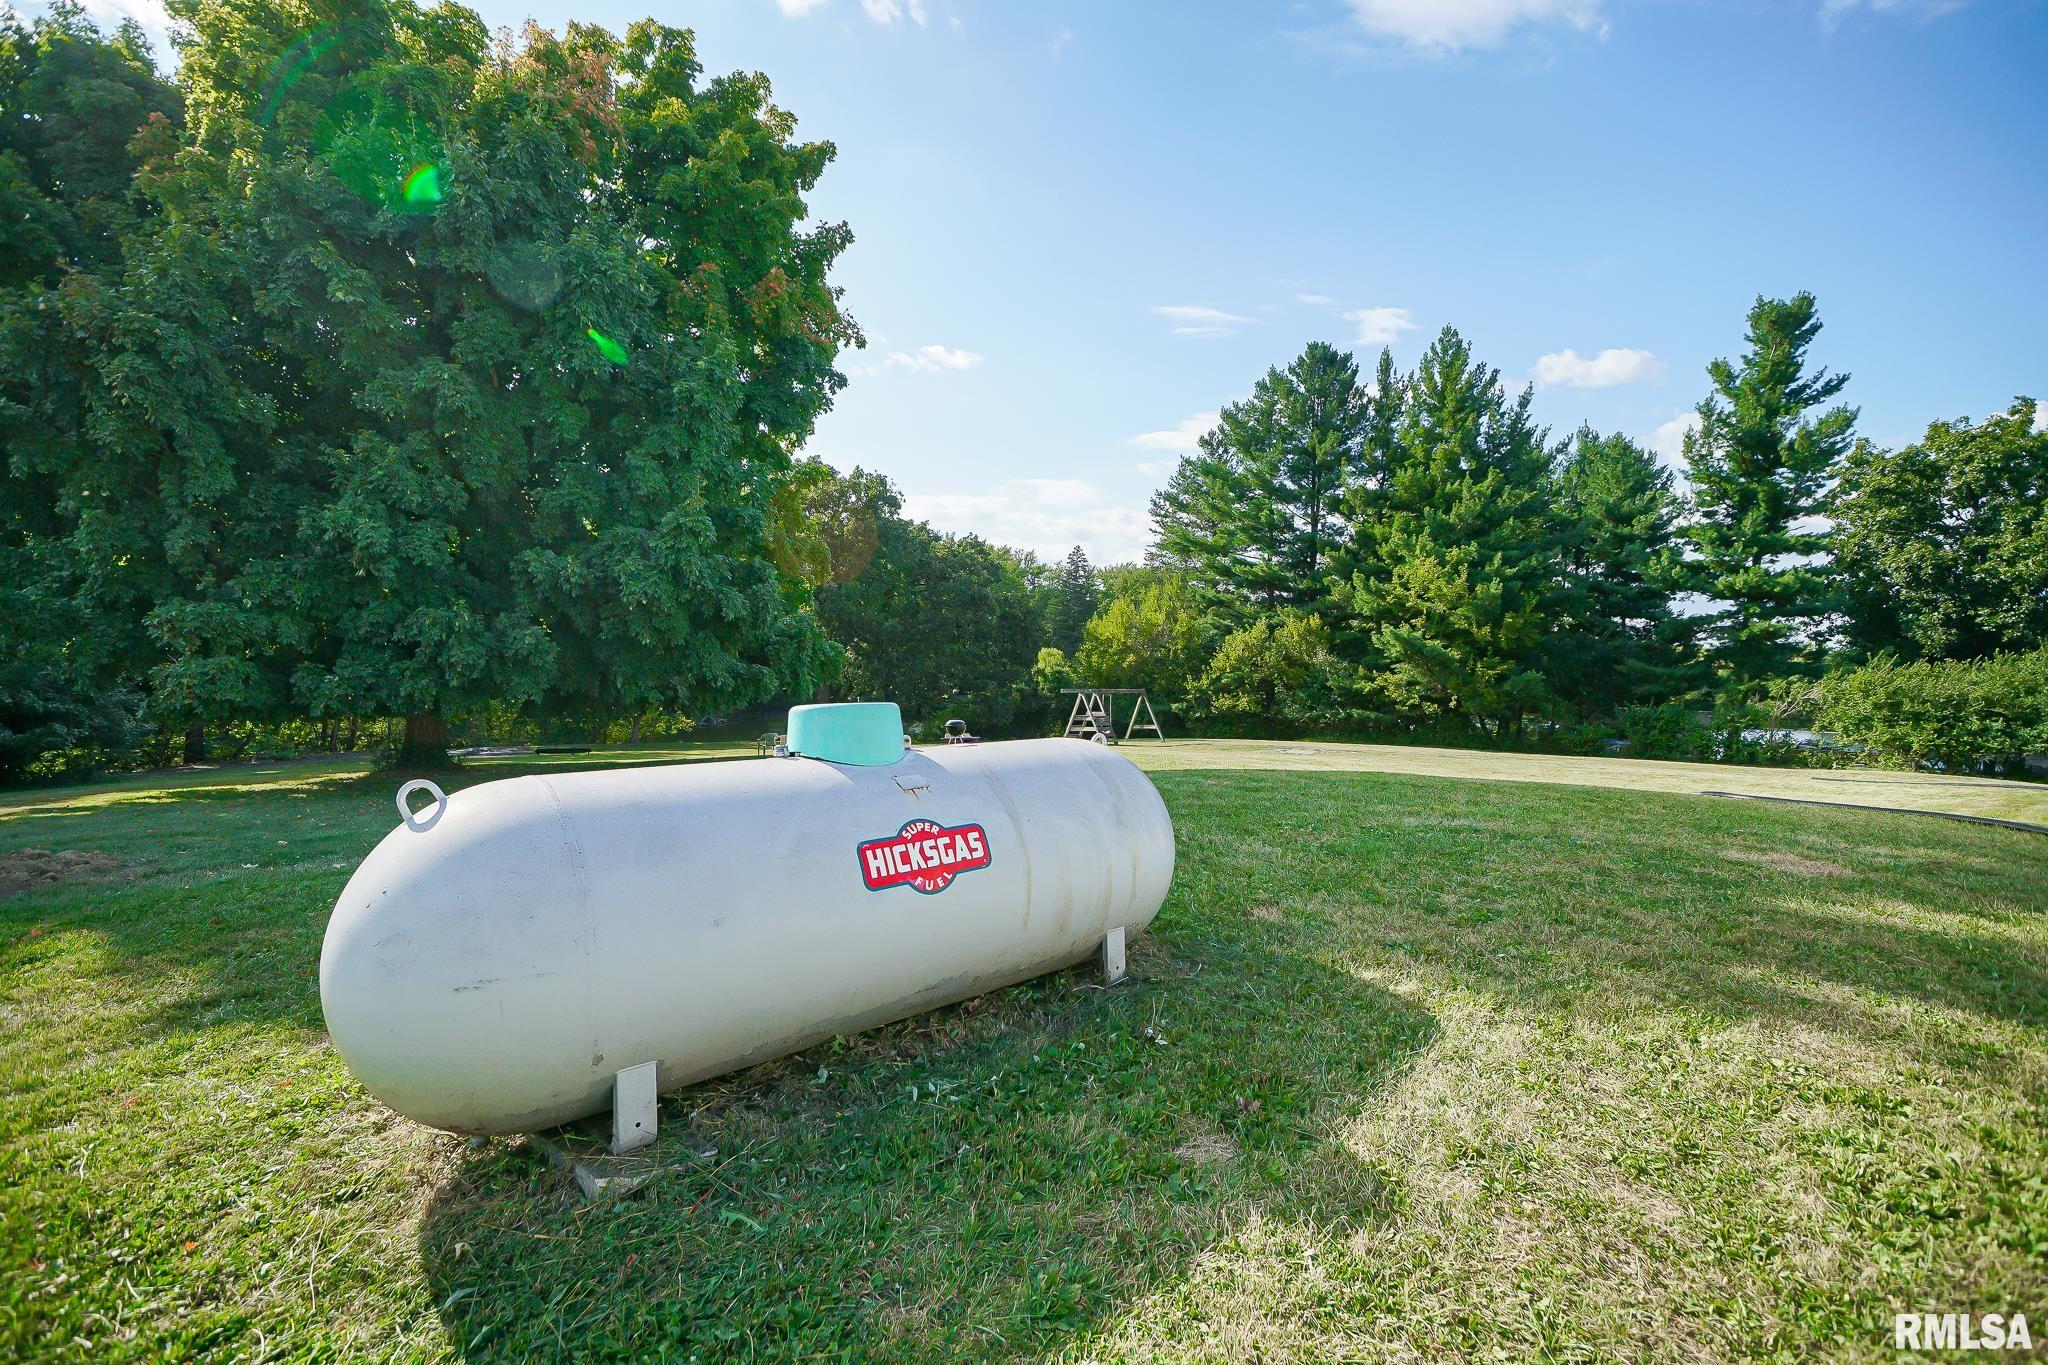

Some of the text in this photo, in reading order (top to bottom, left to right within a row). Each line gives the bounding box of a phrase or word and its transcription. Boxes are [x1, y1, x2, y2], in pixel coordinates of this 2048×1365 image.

[901, 822, 940, 840] SUPER
[865, 831, 985, 879] HICKSGAS
[914, 871, 953, 891] FUEL
